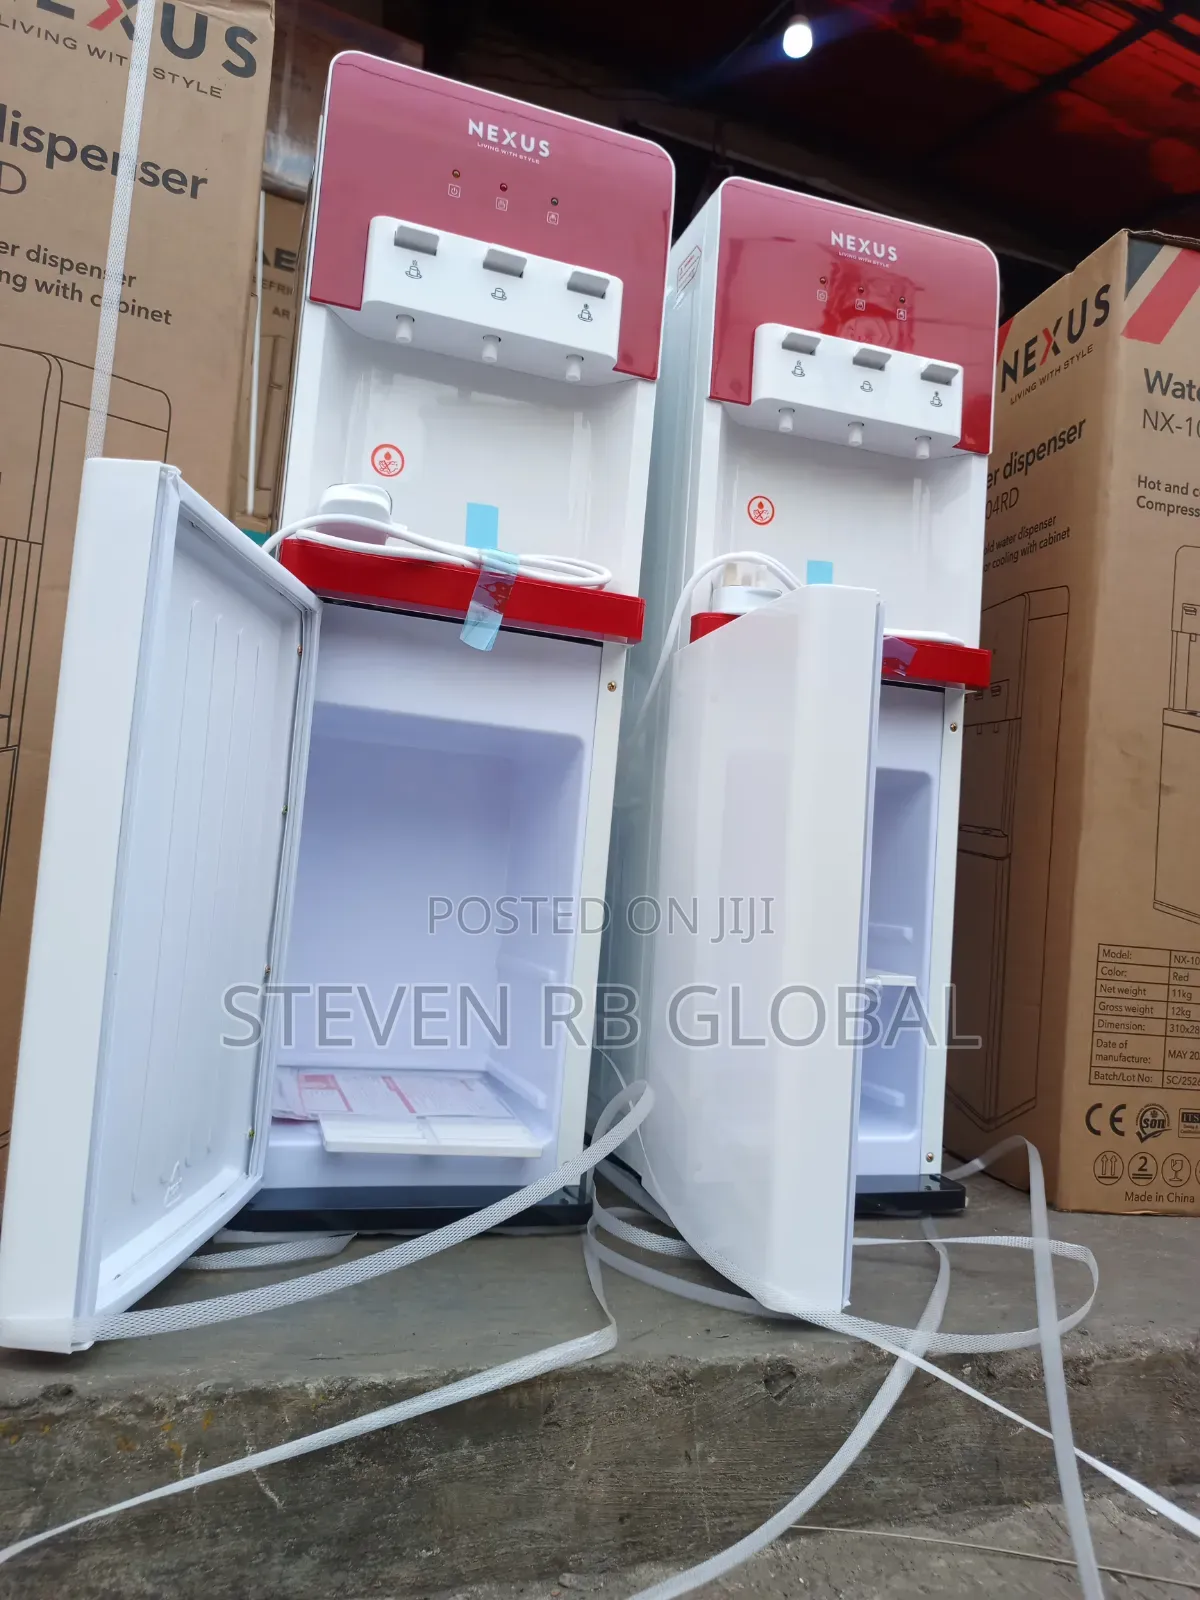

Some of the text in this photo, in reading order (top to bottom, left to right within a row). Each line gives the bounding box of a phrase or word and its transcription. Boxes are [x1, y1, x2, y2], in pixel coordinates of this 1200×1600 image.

[87, 44, 128, 67] WIT
[152, 67, 223, 99] STYLE
[467, 118, 550, 158] NEXUS
[477, 142, 540, 165] LIVING WITH STYLE
[831, 229, 898, 262] NEXUS
[838, 251, 890, 268] LIVING WITH STYLE
[34, 279, 83, 303] with
[1001, 283, 1111, 393] NEXUS
[1010, 344, 1094, 406] LIVING WITH STYLE
[1002, 418, 1087, 480] dispenser
[1137, 474, 1162, 492] Hot
[1164, 482, 1190, 496] and
[995, 533, 1017, 551] water
[1017, 515, 1057, 540] dispenser
[992, 549, 1019, 569] cooling
[1020, 540, 1038, 557] with
[1038, 526, 1071, 550] cabinet
[1102, 949, 1132, 960] Model:
[1100, 966, 1190, 982] Color: Red
[1099, 984, 1193, 1001] Net weight 11kg
[1098, 1001, 1192, 1019] Gross weight 12kg
[1097, 1019, 1146, 1031] Dimension:
[1096, 1039, 1128, 1049] Date of
[1095, 1053, 1151, 1065] manufacture:
[1168, 1049, 1187, 1060] MAY
[1094, 1071, 1136, 1082] Batch/Lot
[1137, 1072, 1153, 1083] No:
[1085, 1102, 1127, 1137] CE
[1138, 1155, 1148, 1172] 2
[1124, 1191, 1195, 1203] Made in China
